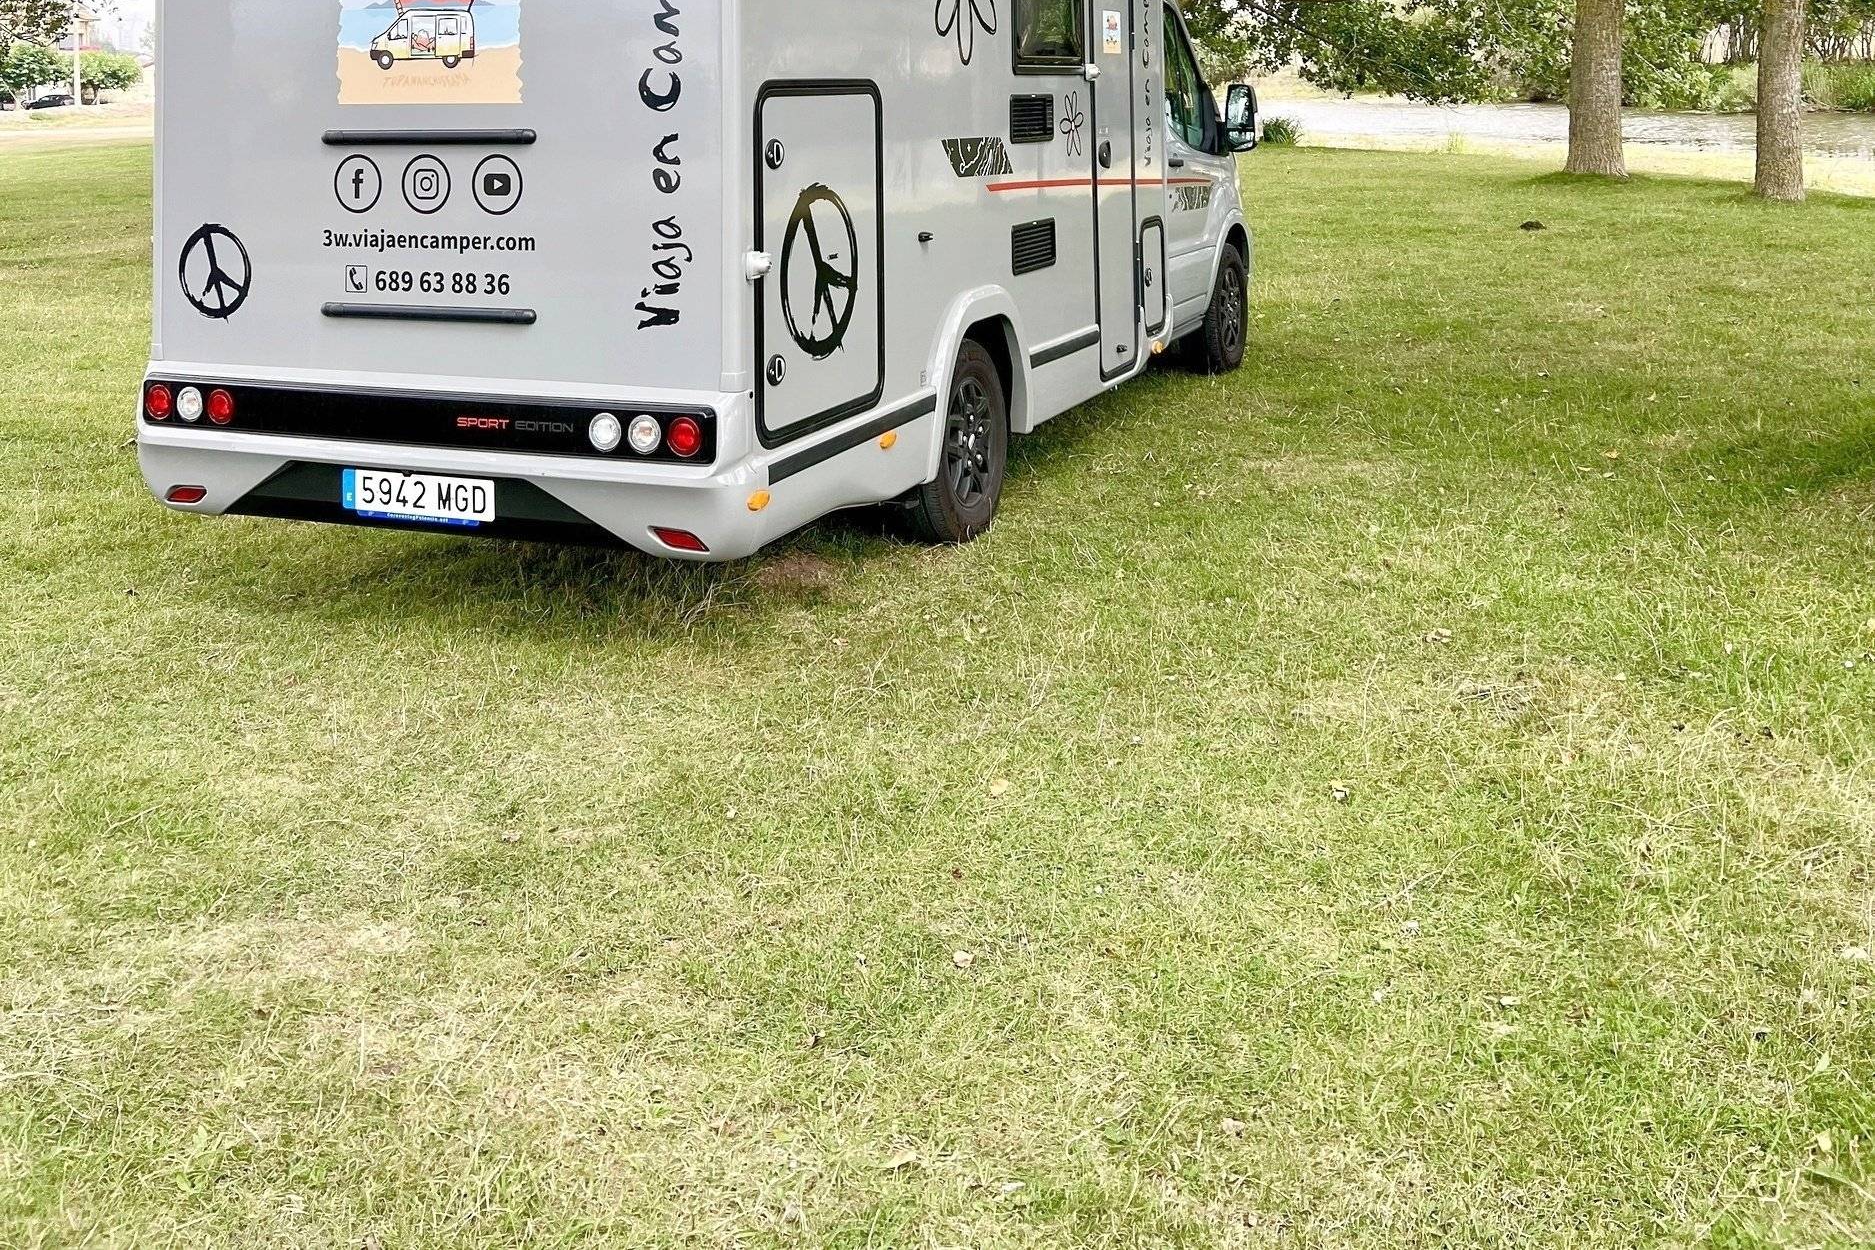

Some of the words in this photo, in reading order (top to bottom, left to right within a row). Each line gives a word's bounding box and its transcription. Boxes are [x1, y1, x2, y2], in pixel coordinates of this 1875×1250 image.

[652, 132, 681, 193] en
[322, 228, 536, 255] 3w.viajaencamper.com
[375, 270, 414, 293] 689
[419, 271, 445, 293] 63
[451, 272, 477, 295] 88
[483, 273, 510, 296] 36
[634, 215, 693, 330] Viaja
[456, 416, 510, 430] SPORT
[514, 420, 574, 433] EDITION
[362, 476, 426, 508] 5942
[437, 482, 486, 513] MGD
